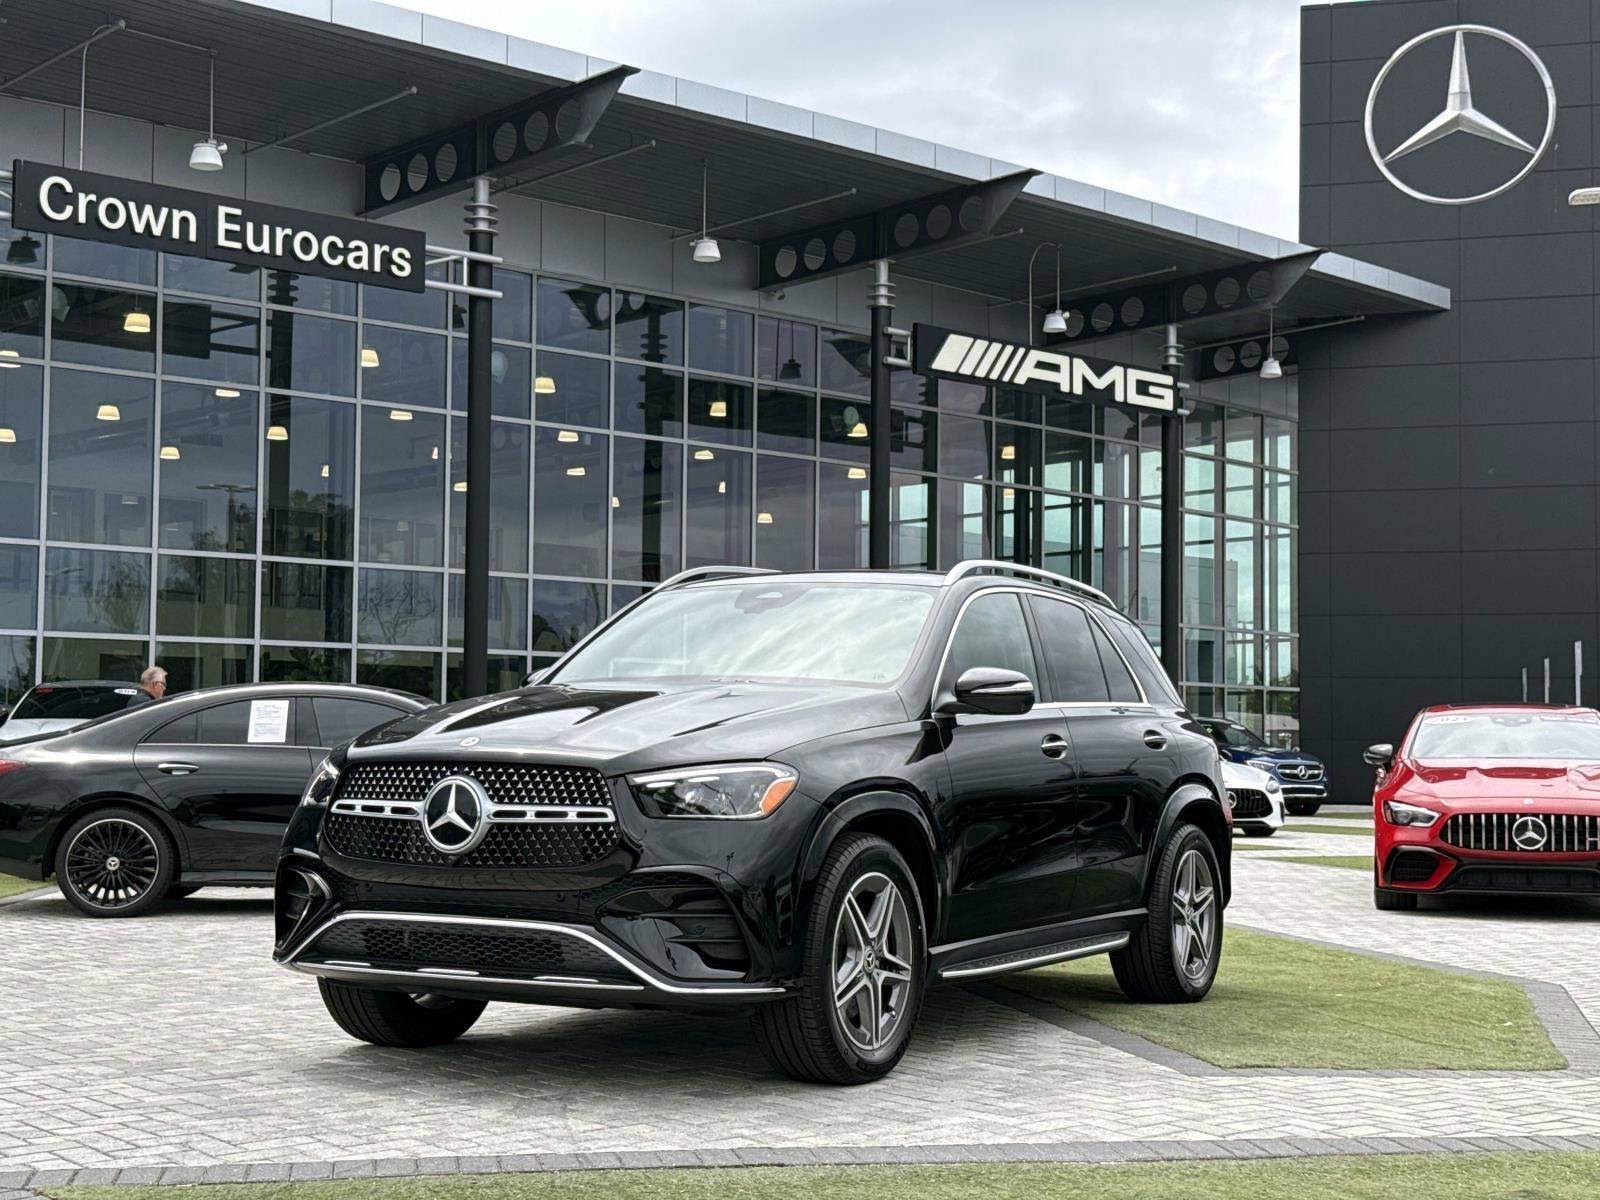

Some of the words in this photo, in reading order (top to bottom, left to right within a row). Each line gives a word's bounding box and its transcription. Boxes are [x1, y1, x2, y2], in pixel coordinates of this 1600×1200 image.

[38, 175, 197, 242] Crown
[216, 205, 413, 278] Eurocars
[1012, 348, 1175, 411] AMG
